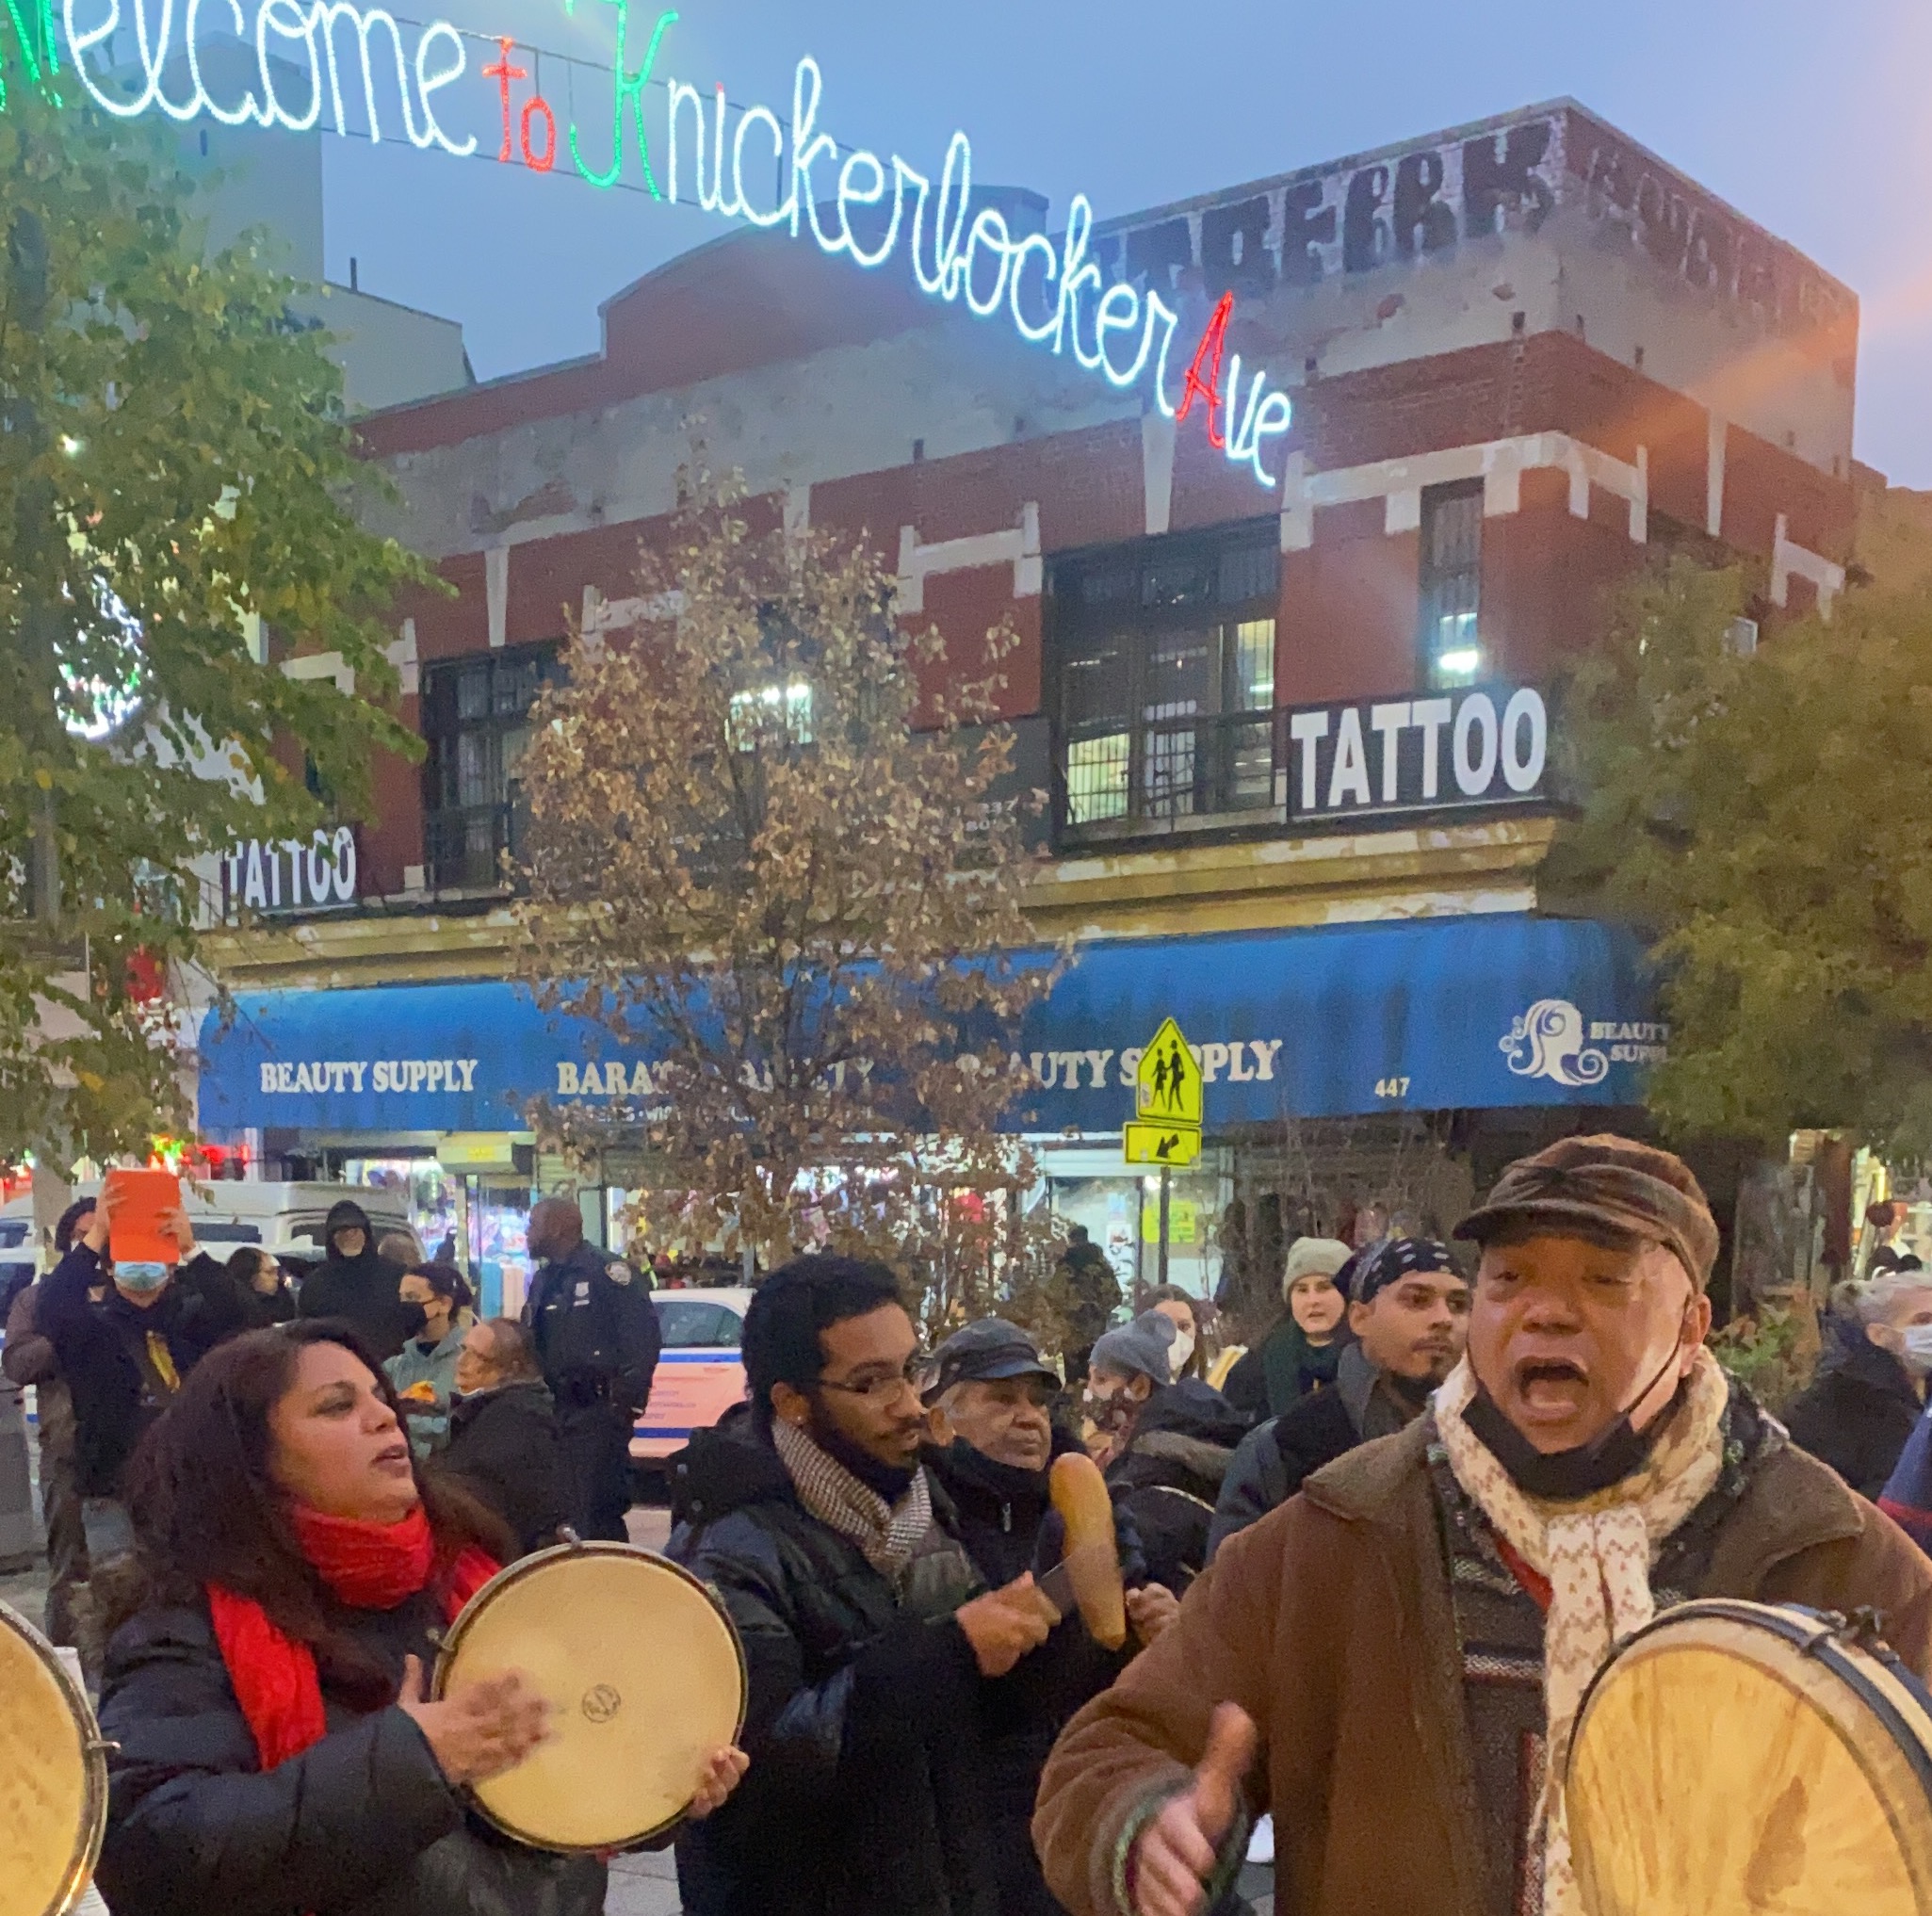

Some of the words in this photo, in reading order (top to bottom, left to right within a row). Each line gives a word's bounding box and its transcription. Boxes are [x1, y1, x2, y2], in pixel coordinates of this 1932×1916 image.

[482, 37, 557, 172] to
[569, 0, 1176, 418] Knickerbocker
[1175, 289, 1291, 487] Ave
[1291, 687, 1548, 810] TATTOO
[224, 825, 357, 909] TATTOO
[260, 1061, 367, 1094] BEAUTY
[373, 1059, 479, 1093] SUPPLY
[556, 1060, 695, 1096] BARAT
[1119, 1039, 1283, 1087] SPLY
[1374, 1077, 1410, 1098] 447
